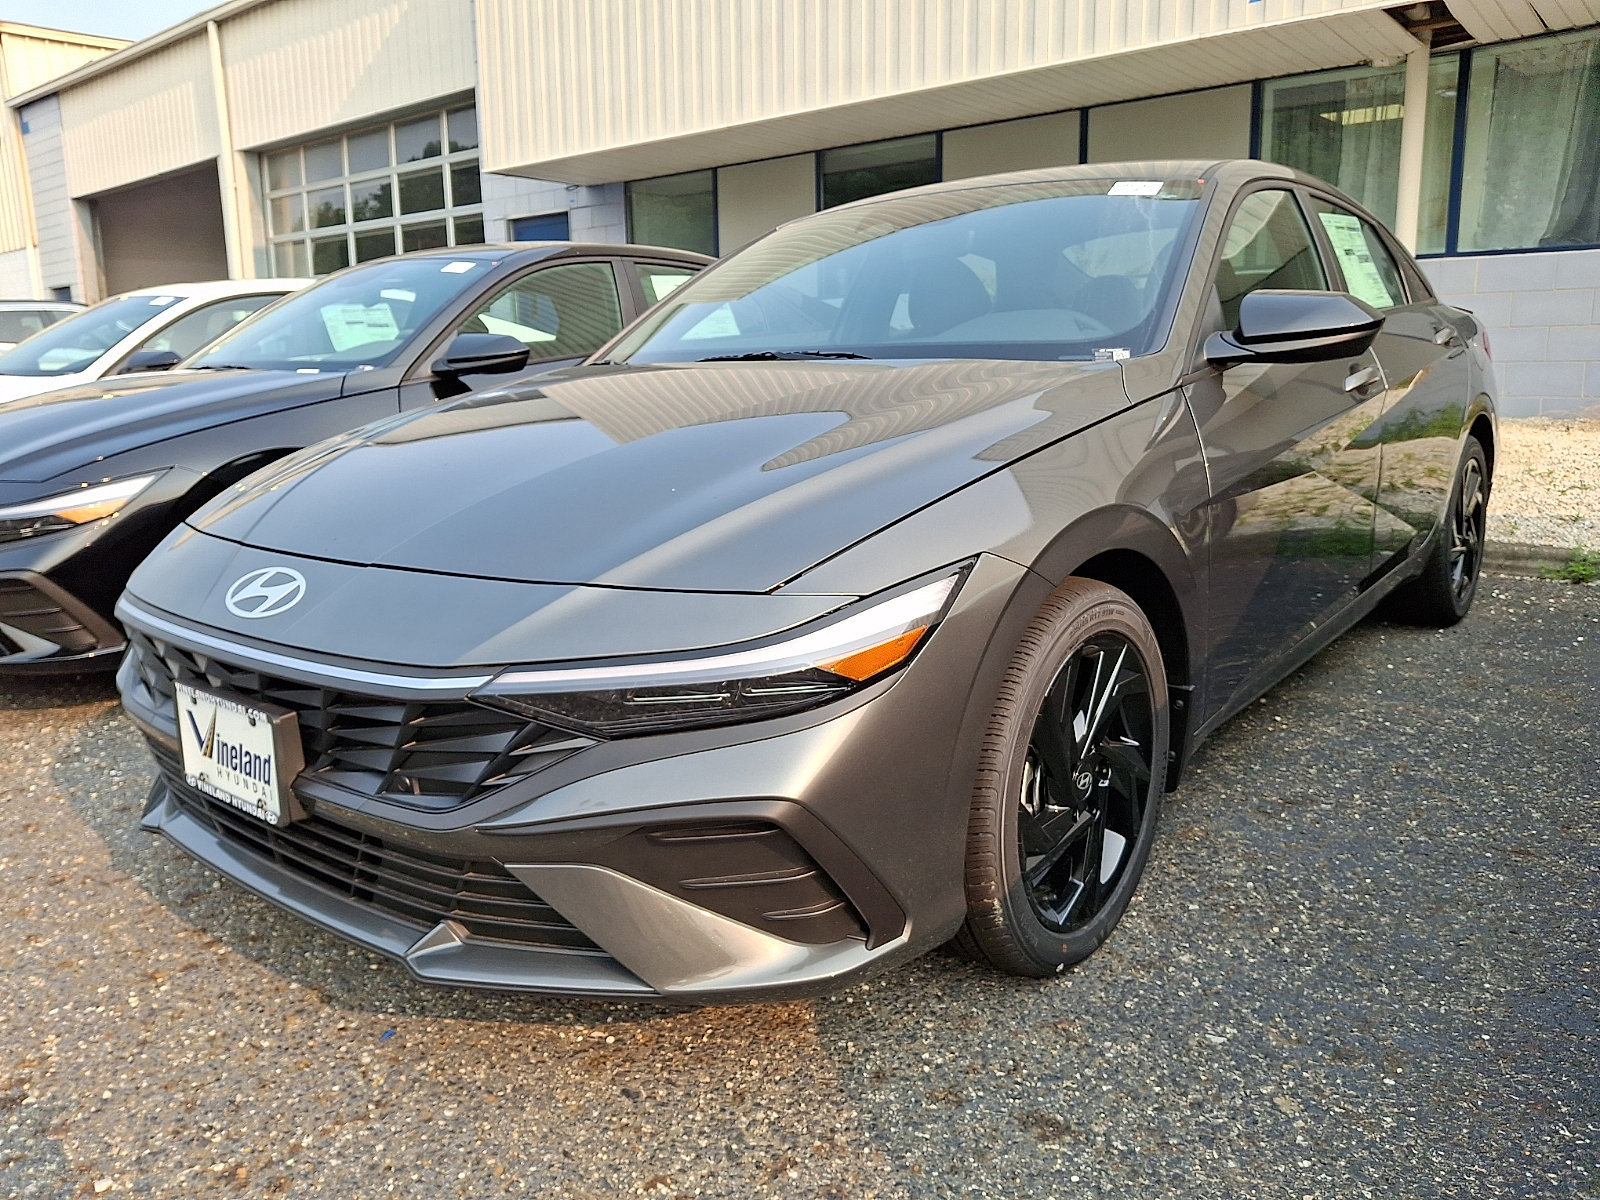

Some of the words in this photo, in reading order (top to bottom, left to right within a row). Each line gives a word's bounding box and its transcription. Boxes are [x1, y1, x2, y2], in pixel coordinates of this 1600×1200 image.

[185, 705, 272, 786] Vineland
[197, 779, 231, 804] VINELAND
[231, 794, 266, 821] HYUNDAI
[216, 767, 273, 801] HYUNDAI
